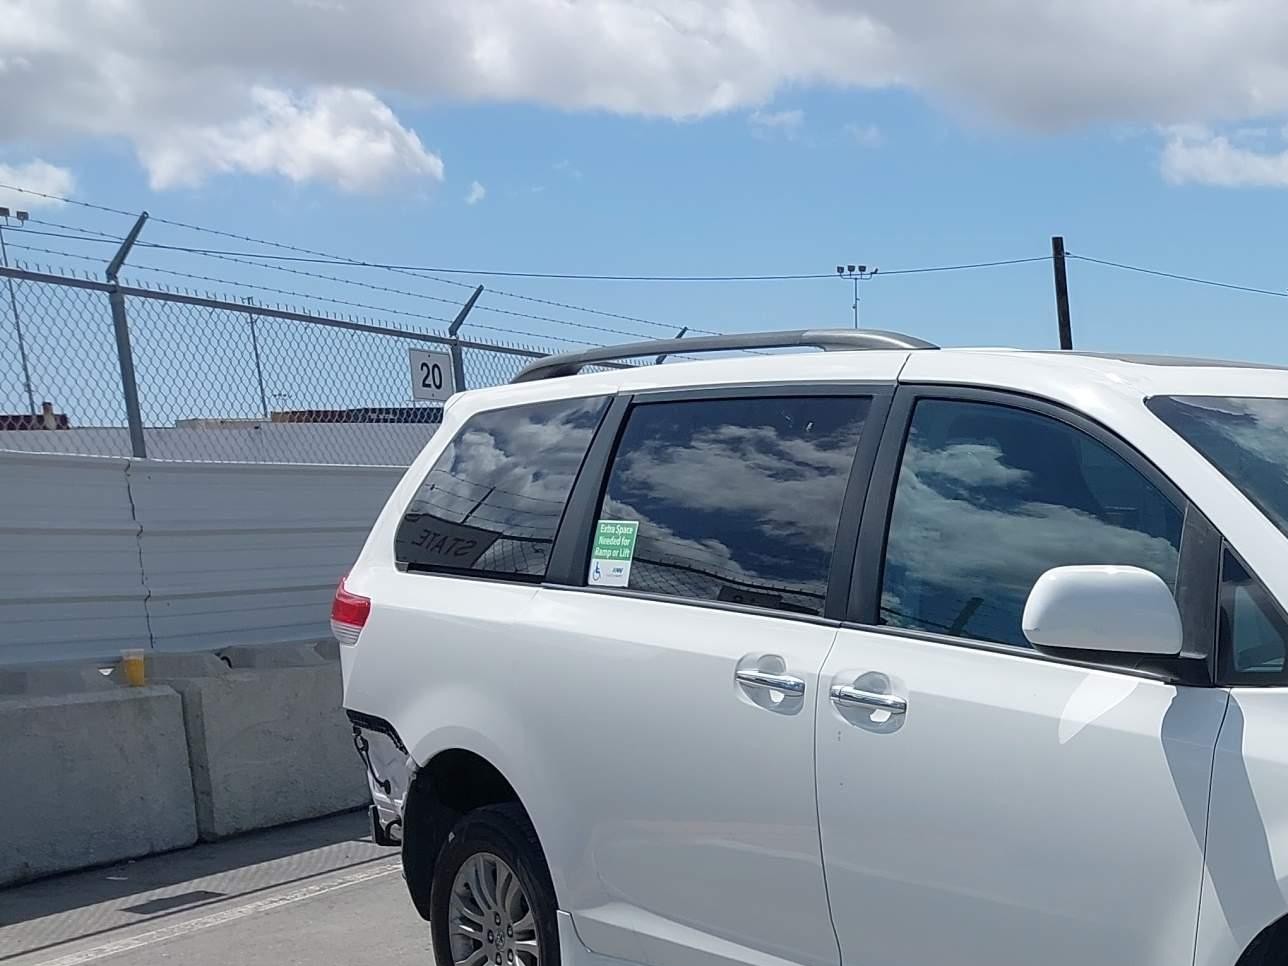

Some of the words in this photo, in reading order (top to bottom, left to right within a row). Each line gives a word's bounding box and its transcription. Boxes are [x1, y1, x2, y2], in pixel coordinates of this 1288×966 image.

[420, 362, 443, 390] 20
[600, 524, 615, 533] Extra
[615, 524, 633, 536] Space
[598, 535, 621, 546] Needed
[621, 536, 631, 546] for
[594, 546, 612, 558] Ramp
[612, 549, 619, 557] or
[619, 547, 630, 558] Lift
